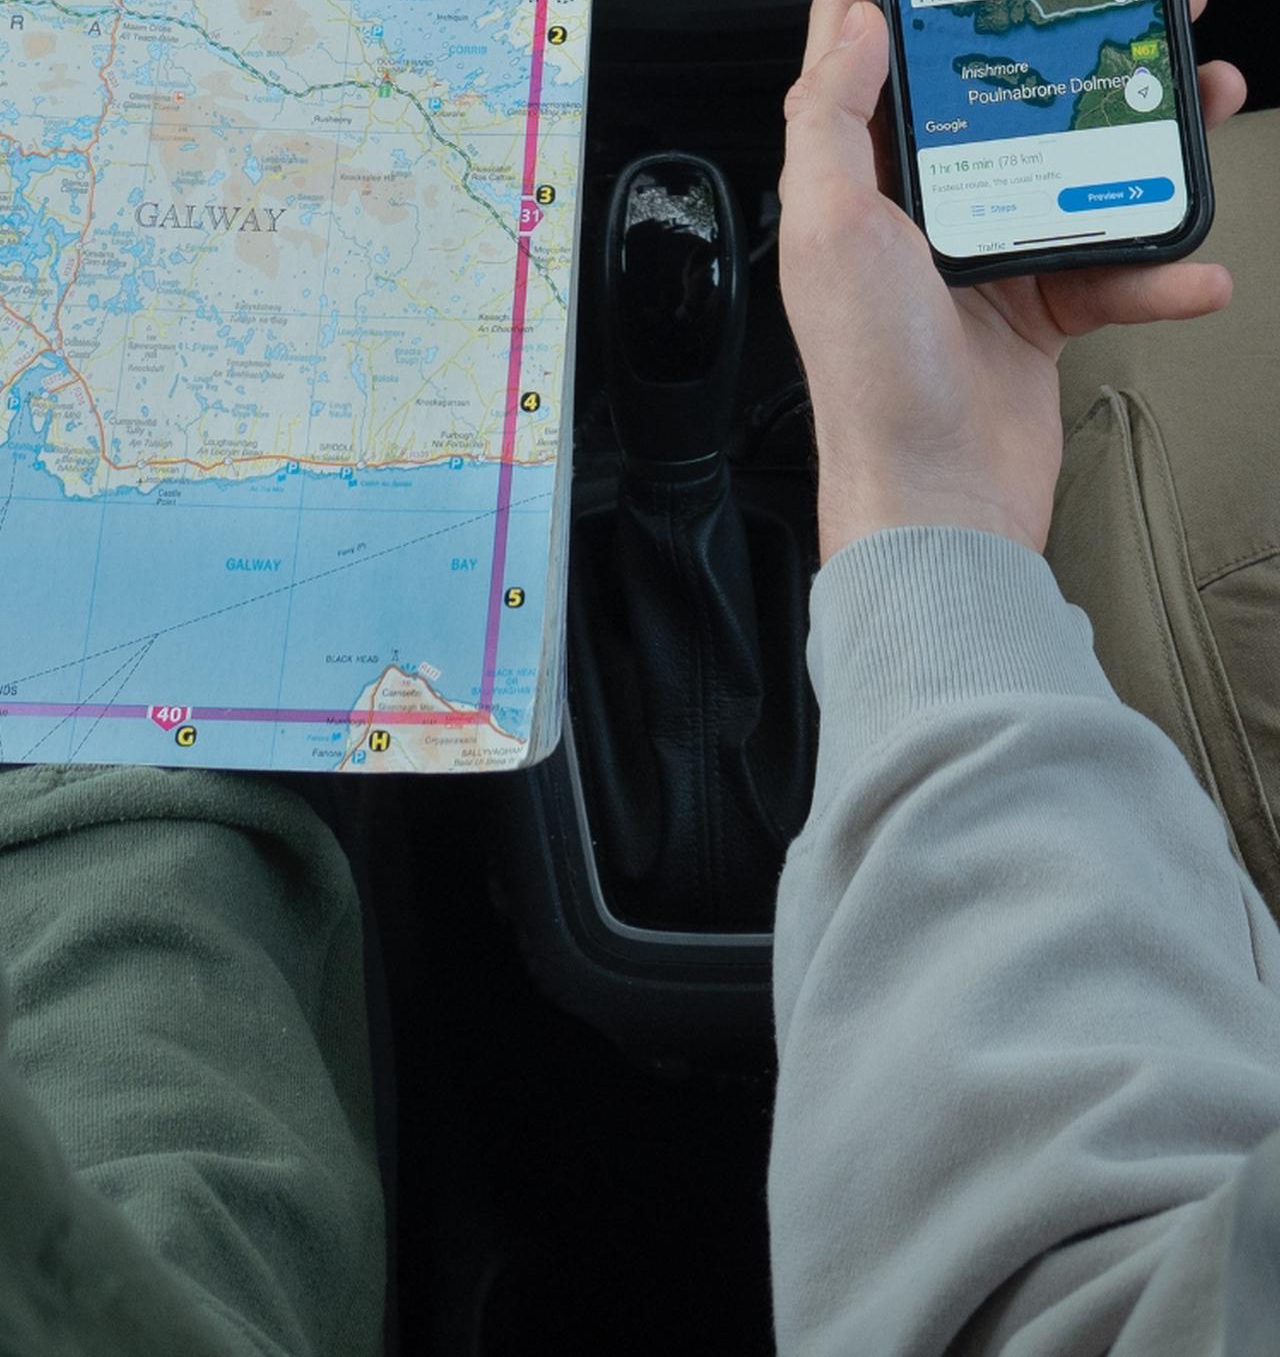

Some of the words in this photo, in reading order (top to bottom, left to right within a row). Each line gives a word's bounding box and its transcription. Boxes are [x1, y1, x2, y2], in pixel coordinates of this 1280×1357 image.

[550, 27, 564, 42] 2
[1132, 44, 1158, 57] N67
[961, 60, 1029, 80] Inishmore
[968, 83, 1066, 105] Poulnabrone
[1071, 74, 1130, 94] Dolmen
[925, 118, 968, 133] Google
[930, 164, 936, 175] 1
[939, 162, 951, 174] hr
[954, 159, 969, 172] 16
[972, 157, 994, 171] min
[538, 187, 553, 203] 3
[1088, 191, 1124, 203] Preview
[521, 208, 540, 223] 31
[990, 202, 1017, 215] Steps
[134, 202, 287, 233] GALWAY
[976, 242, 1006, 254] Traffic
[523, 394, 538, 410] 4
[225, 557, 282, 572] GALWAY
[450, 558, 478, 572] BAY
[508, 588, 521, 606] 5
[157, 706, 181, 722] 40
[177, 727, 195, 745] G
[372, 732, 388, 750] H
